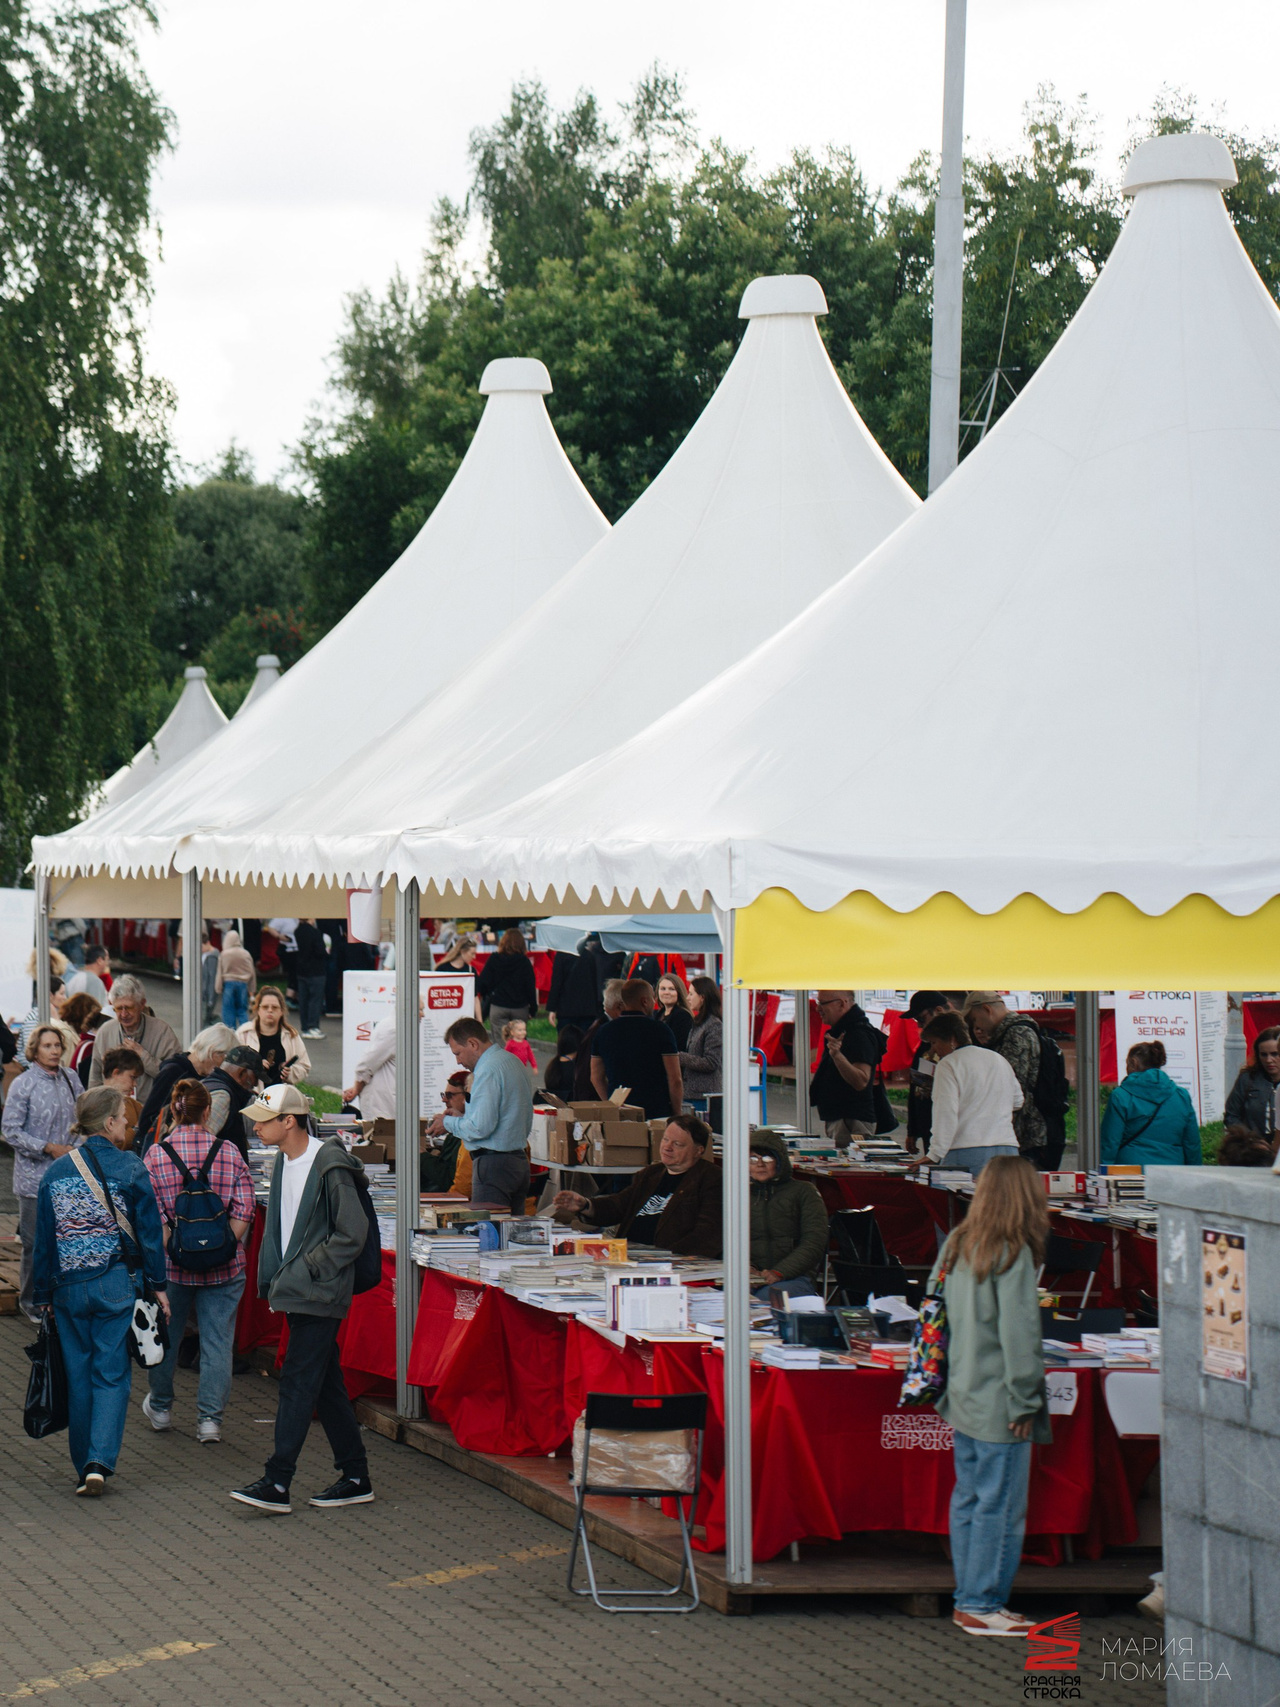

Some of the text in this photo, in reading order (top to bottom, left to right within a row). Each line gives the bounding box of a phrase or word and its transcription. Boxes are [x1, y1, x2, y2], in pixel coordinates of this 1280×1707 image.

[1132, 1016, 1169, 1025] ВЕТКА
[1137, 1027, 1186, 1036] ЗЕЛЕНАЯ
[881, 1414, 955, 1432] КРАСНА
